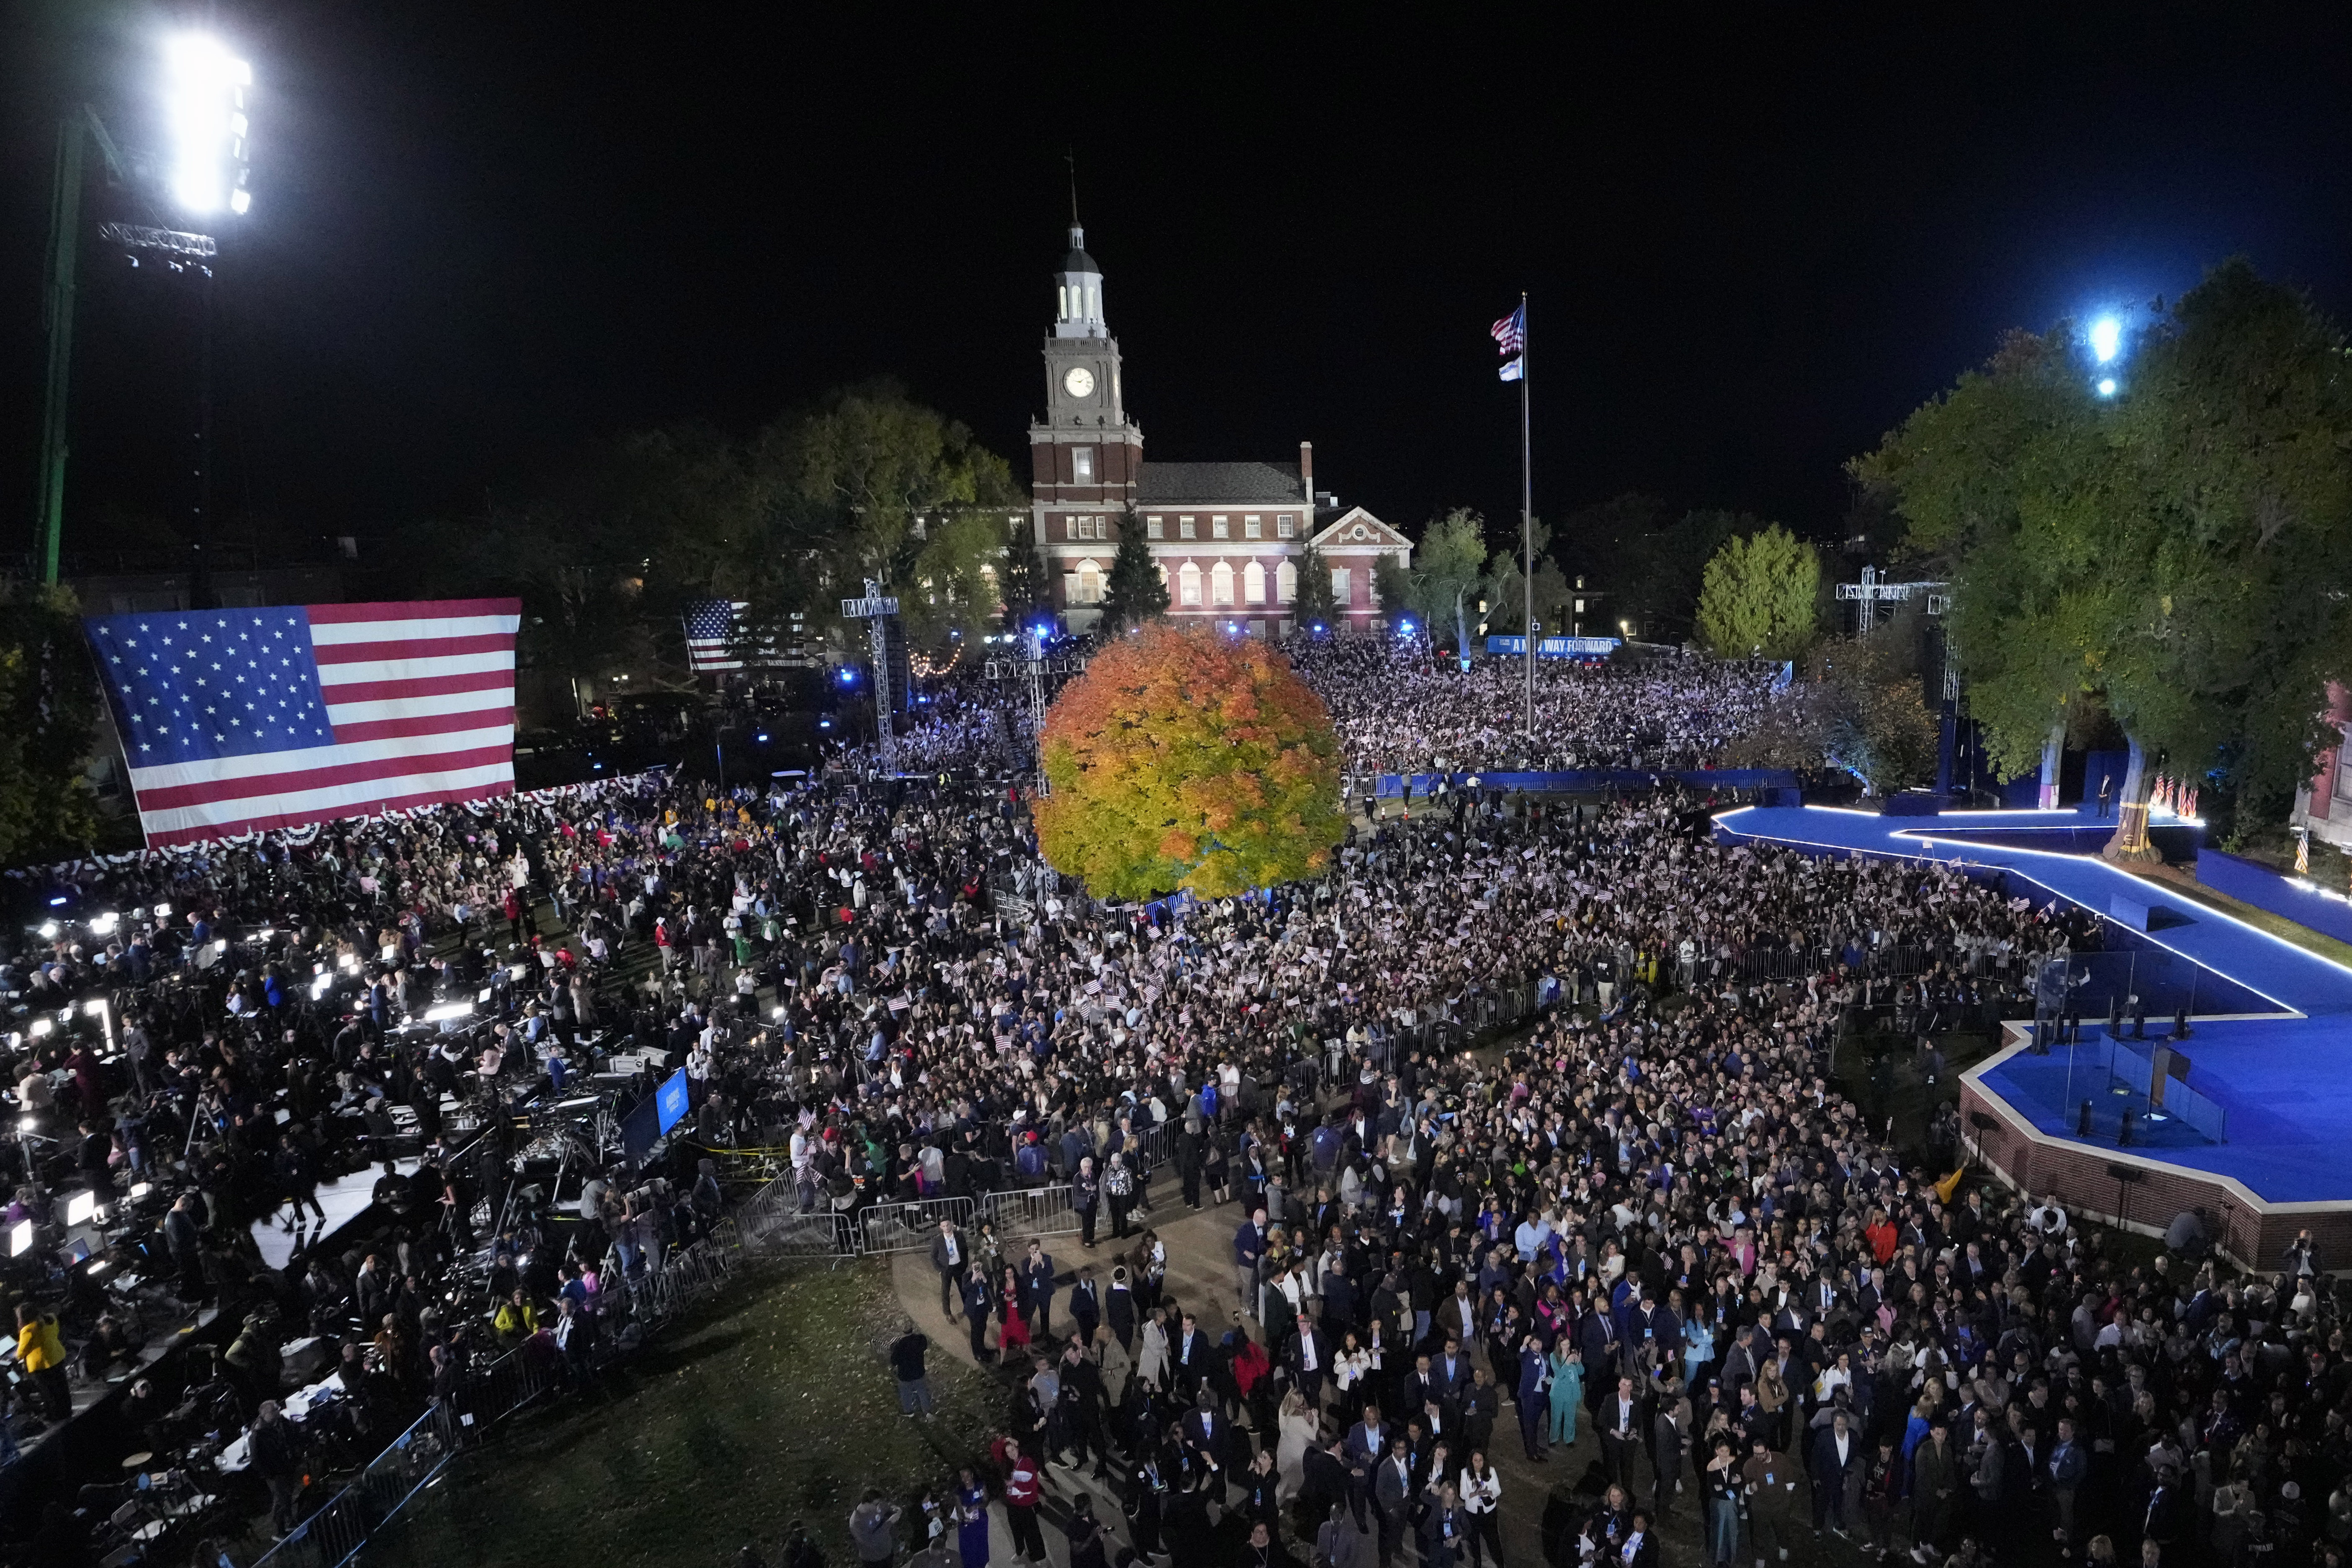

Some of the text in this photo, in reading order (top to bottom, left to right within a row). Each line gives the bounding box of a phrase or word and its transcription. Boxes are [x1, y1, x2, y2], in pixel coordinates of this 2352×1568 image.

[1513, 639, 1520, 651] A
[1544, 640, 1565, 652] WAY
[1567, 640, 1612, 653] FORWARD
